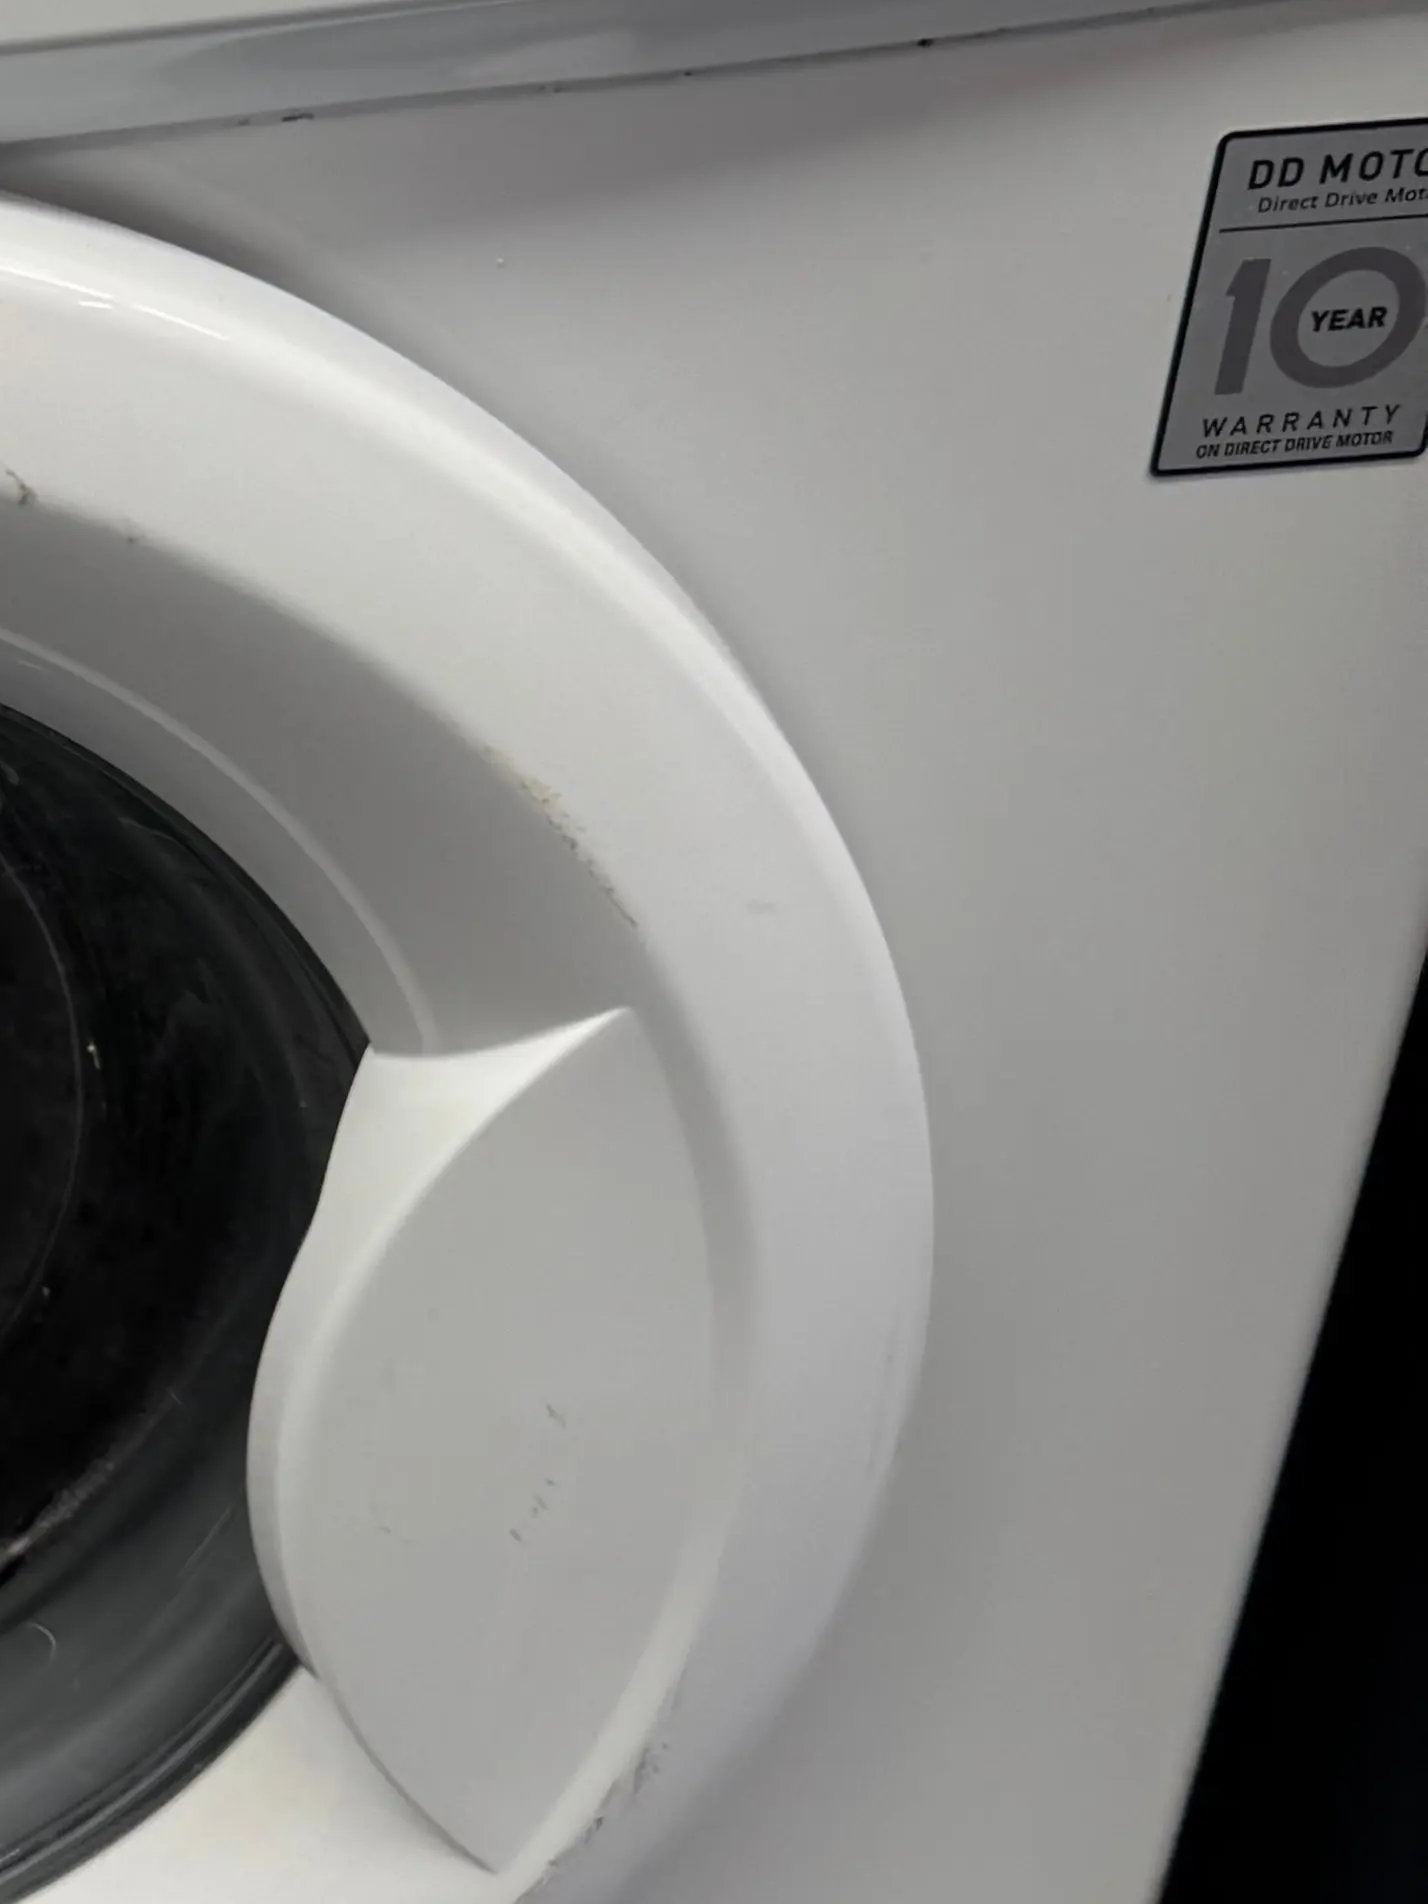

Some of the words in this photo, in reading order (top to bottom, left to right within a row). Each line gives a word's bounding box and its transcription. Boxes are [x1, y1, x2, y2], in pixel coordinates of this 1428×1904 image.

[1246, 155, 1306, 192] DD
[1256, 195, 1320, 215] Direct
[1323, 190, 1380, 209] Drive
[1383, 186, 1428, 204] Mot
[1213, 246, 1427, 396] 10
[1309, 304, 1390, 334] YEAR
[1200, 402, 1402, 439] WARRANTY
[1195, 444, 1221, 460] ON
[1223, 437, 1283, 458] DIRECT
[1283, 433, 1335, 453] DRIVE
[1334, 429, 1395, 449] MOTOR
